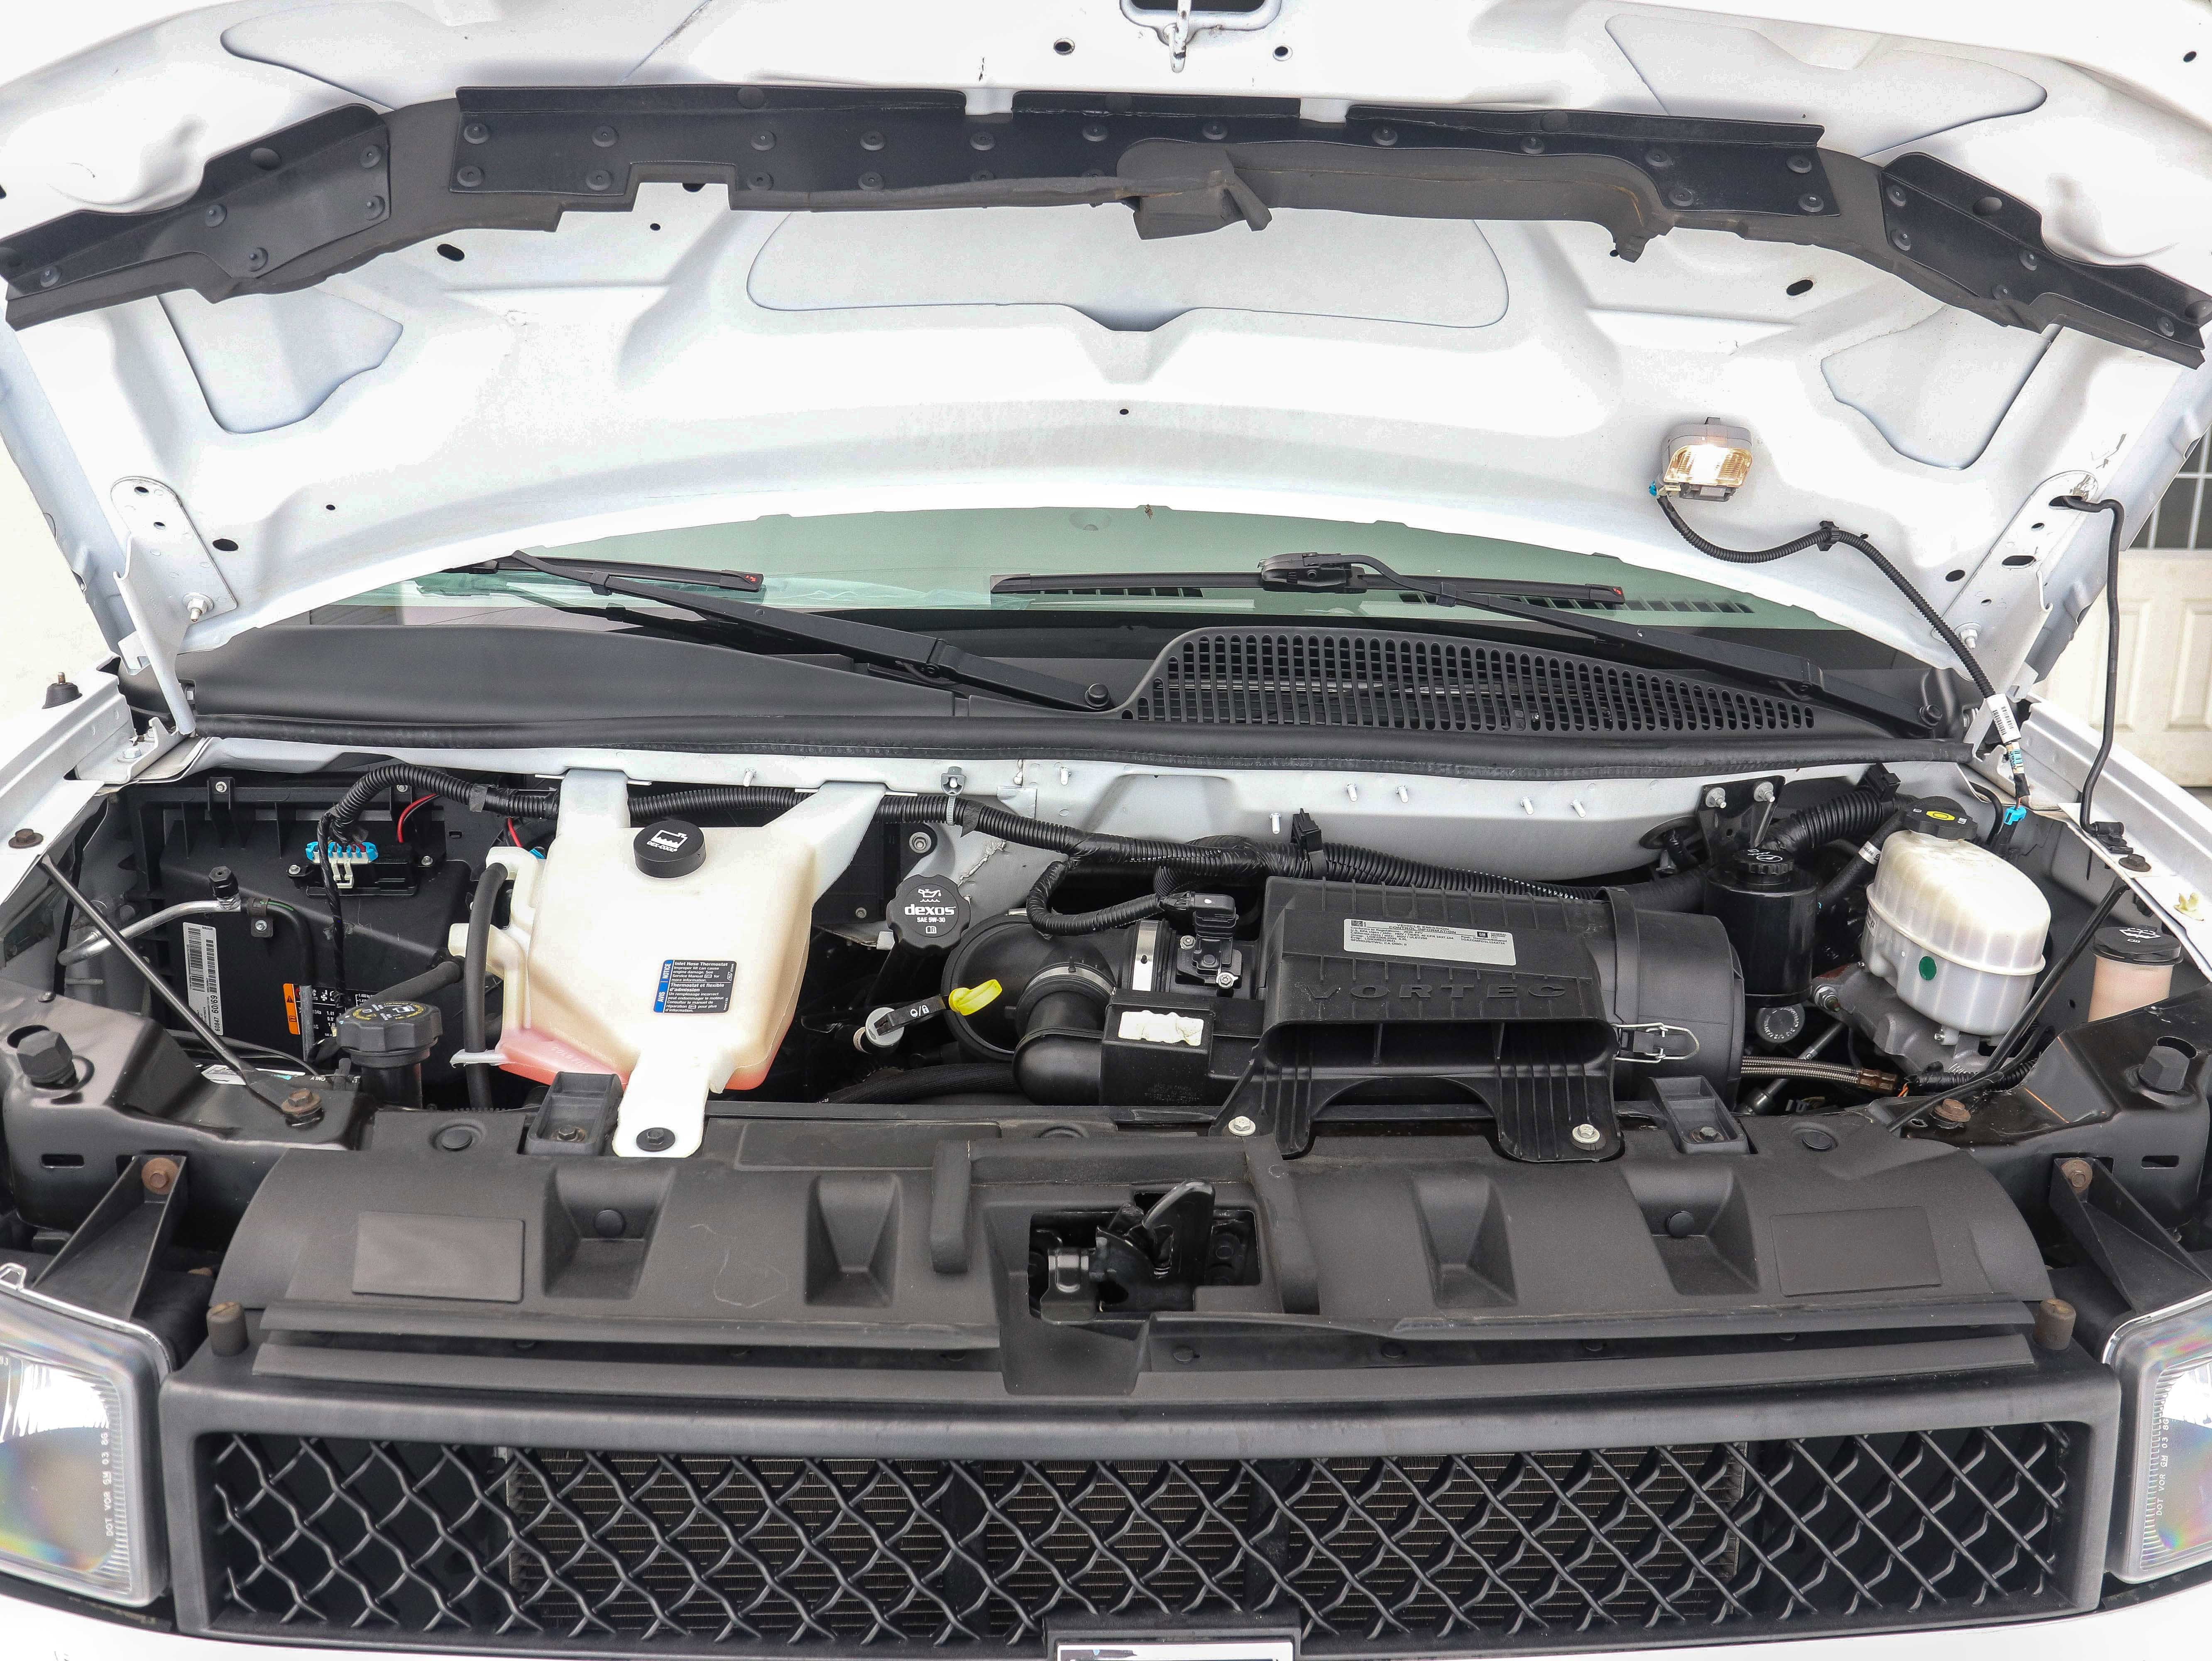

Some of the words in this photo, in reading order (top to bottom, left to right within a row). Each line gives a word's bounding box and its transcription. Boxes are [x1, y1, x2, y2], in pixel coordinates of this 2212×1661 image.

[662, 963, 671, 979] NOTICE
[1308, 983, 1566, 998] VORTEC
[2163, 1418, 2169, 1430] 8G
[2162, 1437, 2168, 1448] 03
[2160, 1455, 2167, 1467] GM
